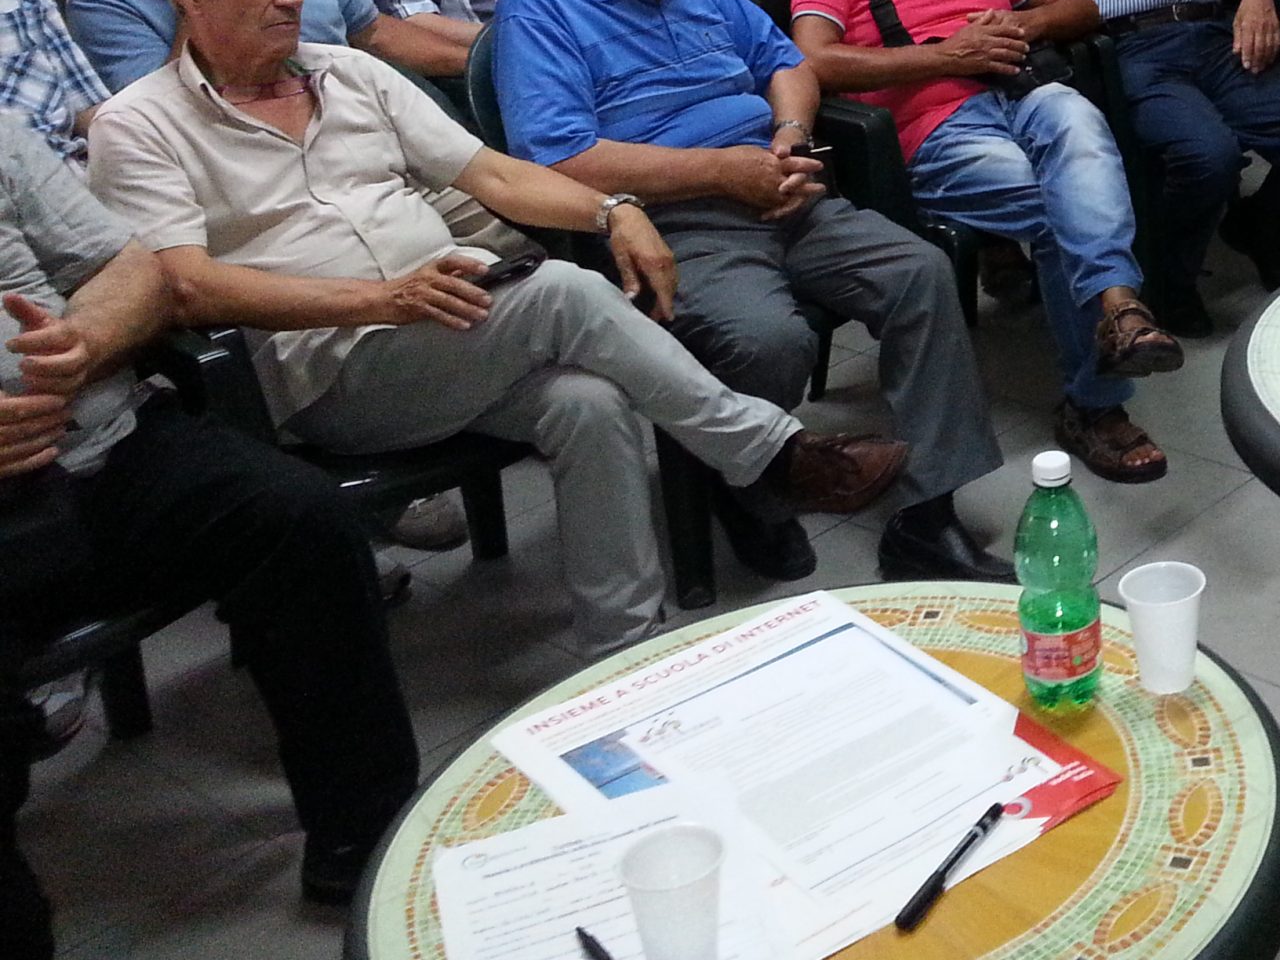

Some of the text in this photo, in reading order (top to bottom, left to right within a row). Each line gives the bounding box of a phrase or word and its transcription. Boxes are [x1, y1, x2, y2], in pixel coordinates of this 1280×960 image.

[526, 598, 822, 736] INSIEME A SCUOLA DI INTERNET
